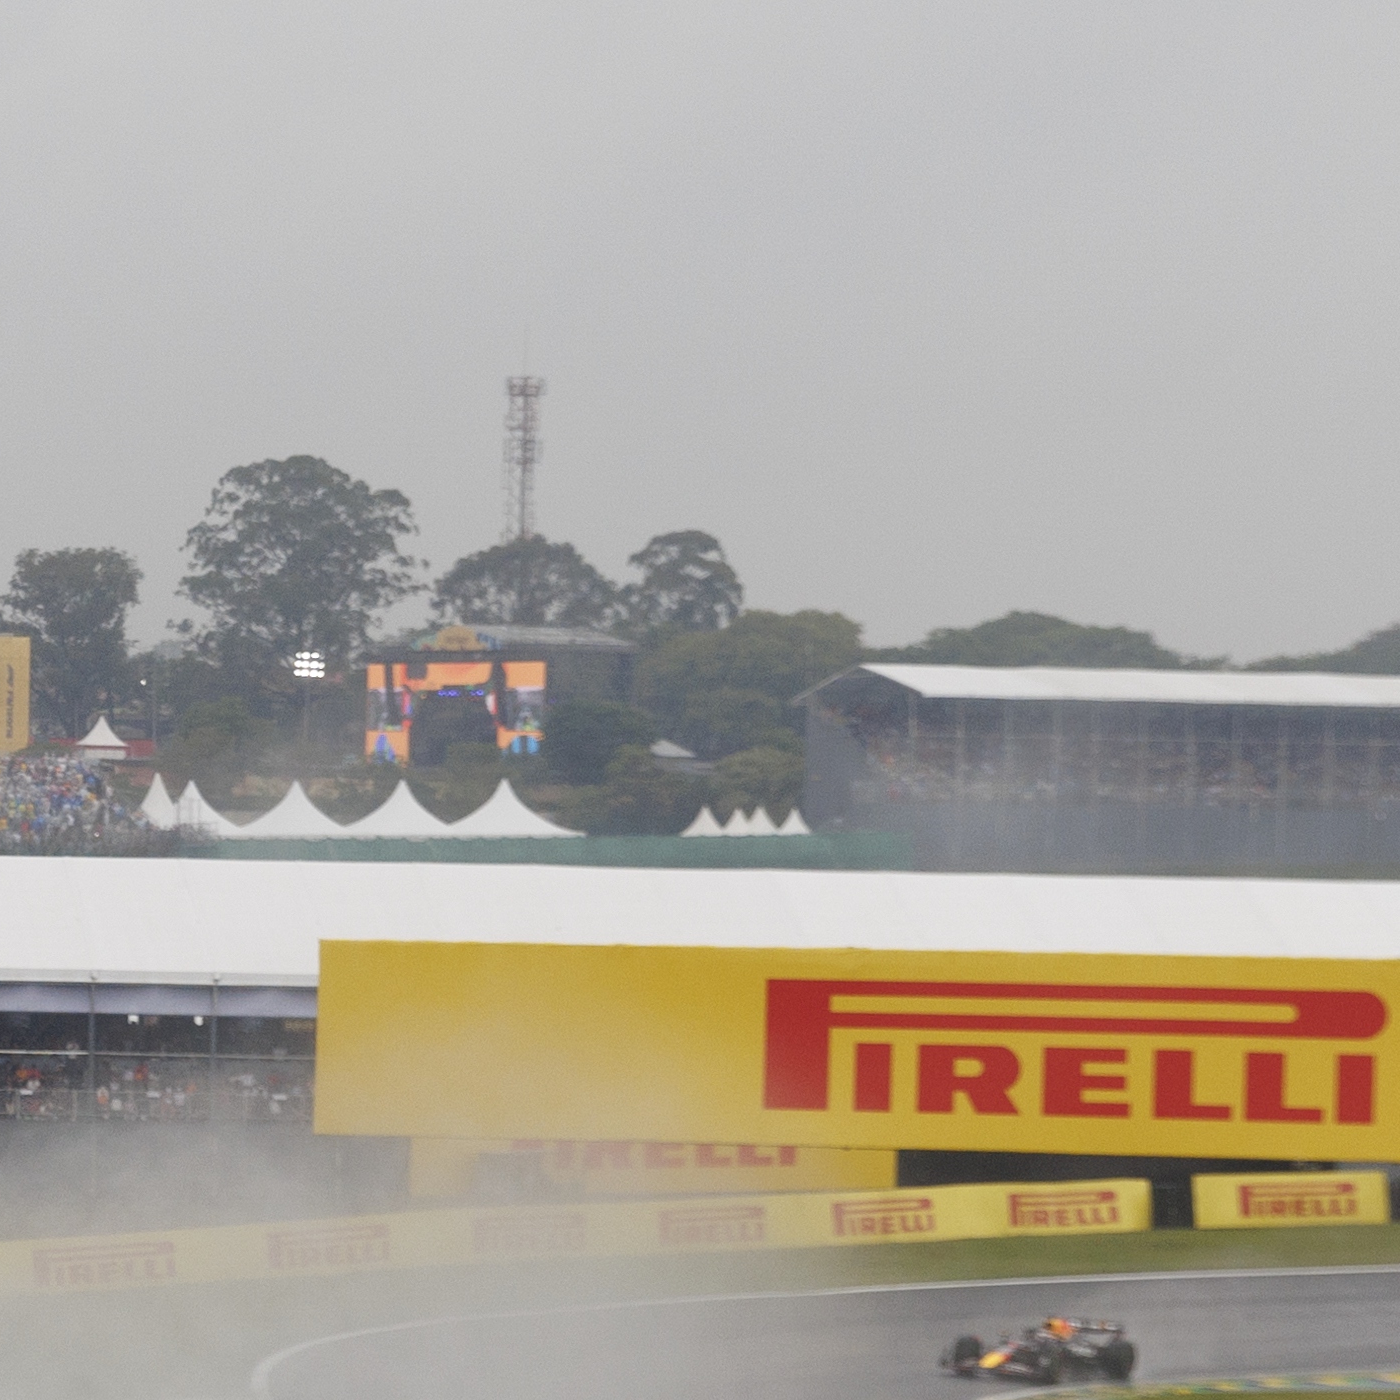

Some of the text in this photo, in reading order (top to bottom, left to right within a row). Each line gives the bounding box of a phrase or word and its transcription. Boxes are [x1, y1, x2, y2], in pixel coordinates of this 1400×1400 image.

[764, 978, 1388, 1125] PIRELLI
[832, 1197, 936, 1237] PIRELLI
[1007, 1190, 1120, 1228] PIRELLI
[1238, 1182, 1358, 1218] PIRELLI
[658, 1206, 767, 1245] PIRELLI
[32, 1241, 177, 1288] PIRELLI
